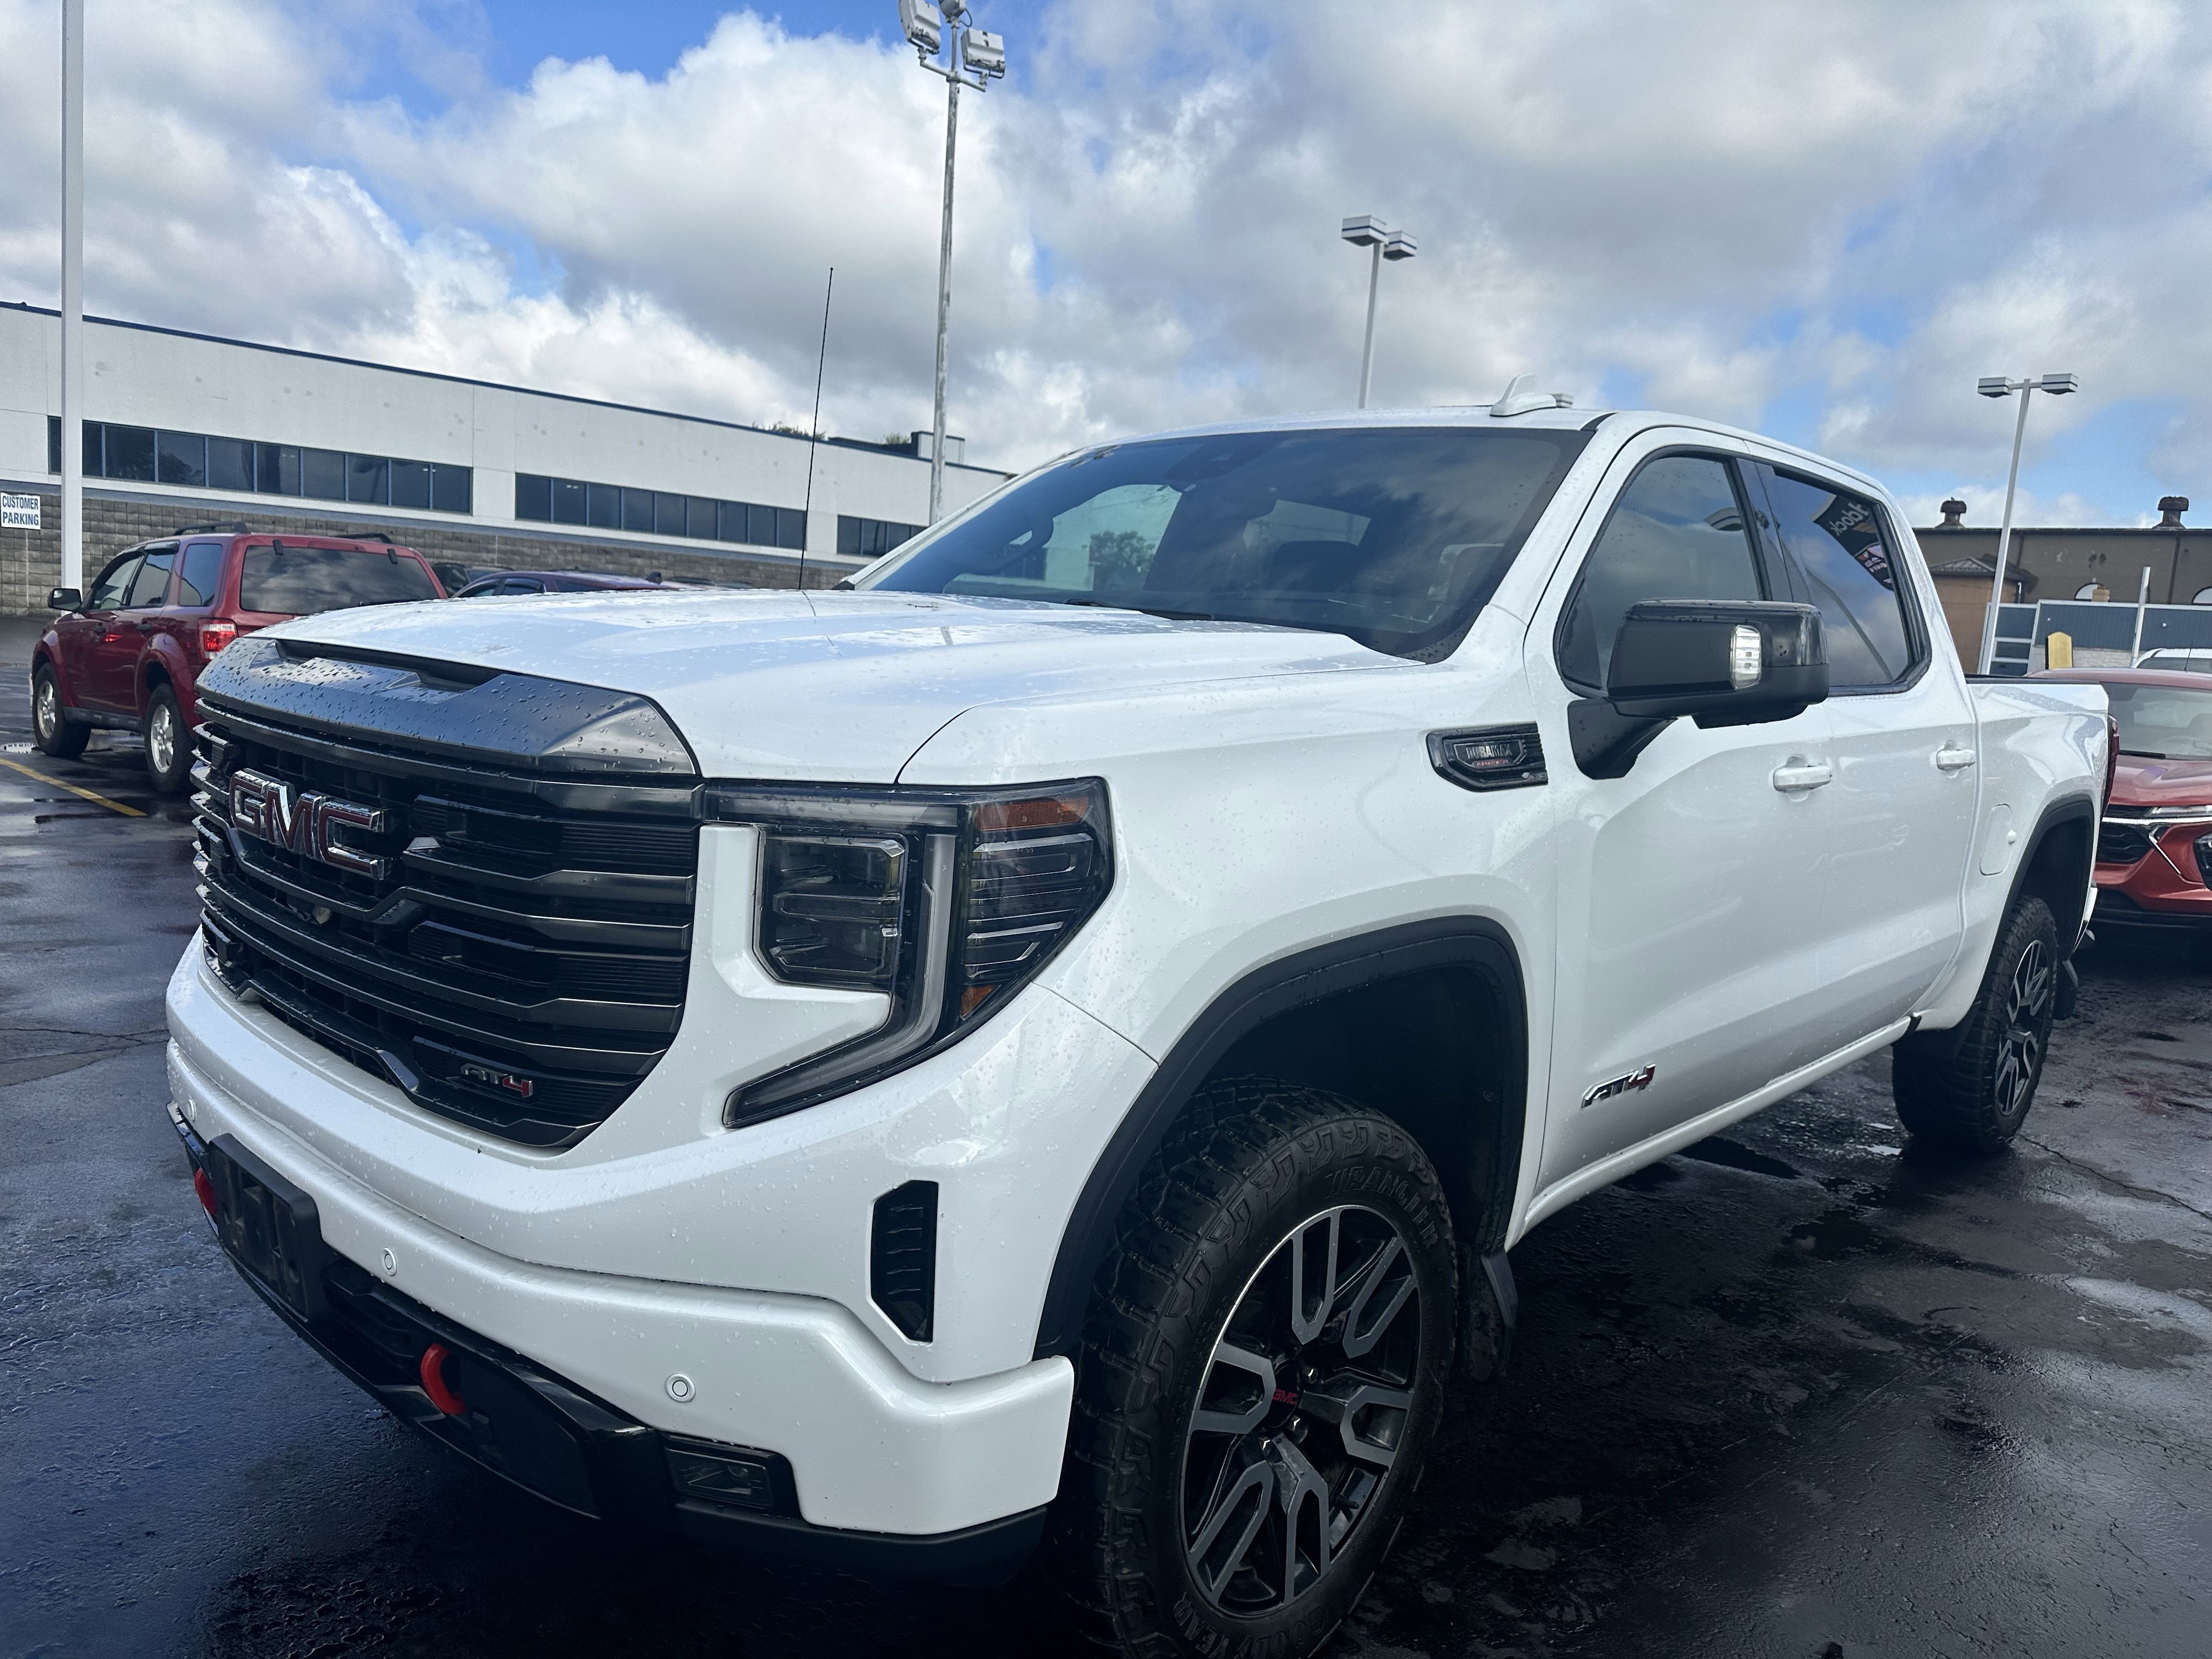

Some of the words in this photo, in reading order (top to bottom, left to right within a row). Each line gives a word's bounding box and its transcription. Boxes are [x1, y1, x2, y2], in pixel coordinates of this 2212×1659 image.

[2, 495, 38, 510] CUSTOMER
[3, 512, 39, 526] PARKING
[1466, 743, 1513, 759] DURAMAX
[229, 769, 385, 881] GMC
[460, 1063, 534, 1098] AT4
[1581, 1063, 1656, 1108] AT4
[1273, 1388, 1299, 1405] GMC
